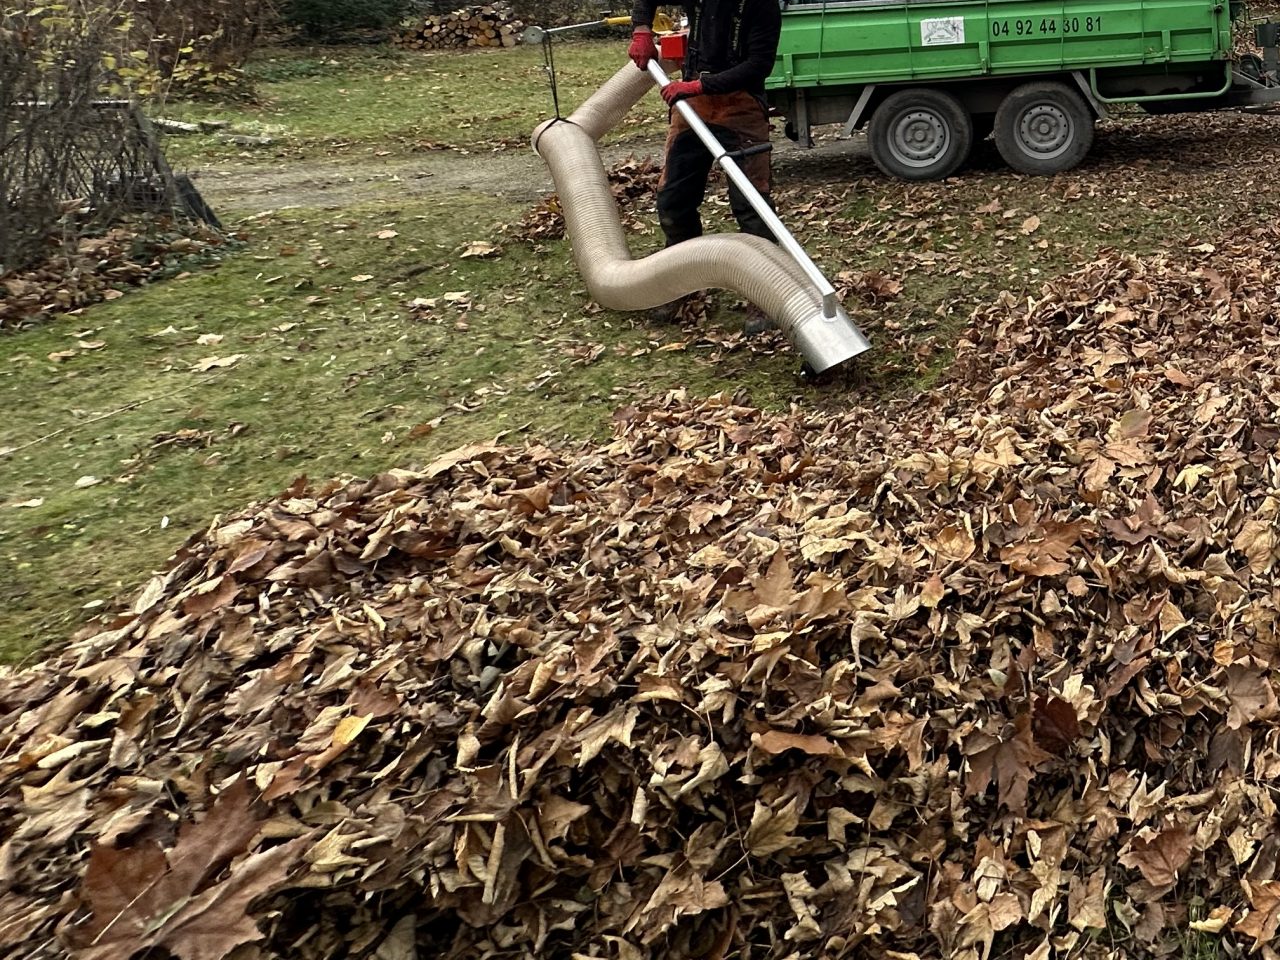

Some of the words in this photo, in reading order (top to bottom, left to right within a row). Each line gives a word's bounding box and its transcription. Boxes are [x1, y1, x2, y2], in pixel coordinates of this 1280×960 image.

[992, 21, 1010, 37] 04
[1016, 19, 1033, 36] 92
[1039, 18, 1057, 34] 44
[1063, 17, 1079, 33] 30
[1086, 16, 1101, 32] 81
